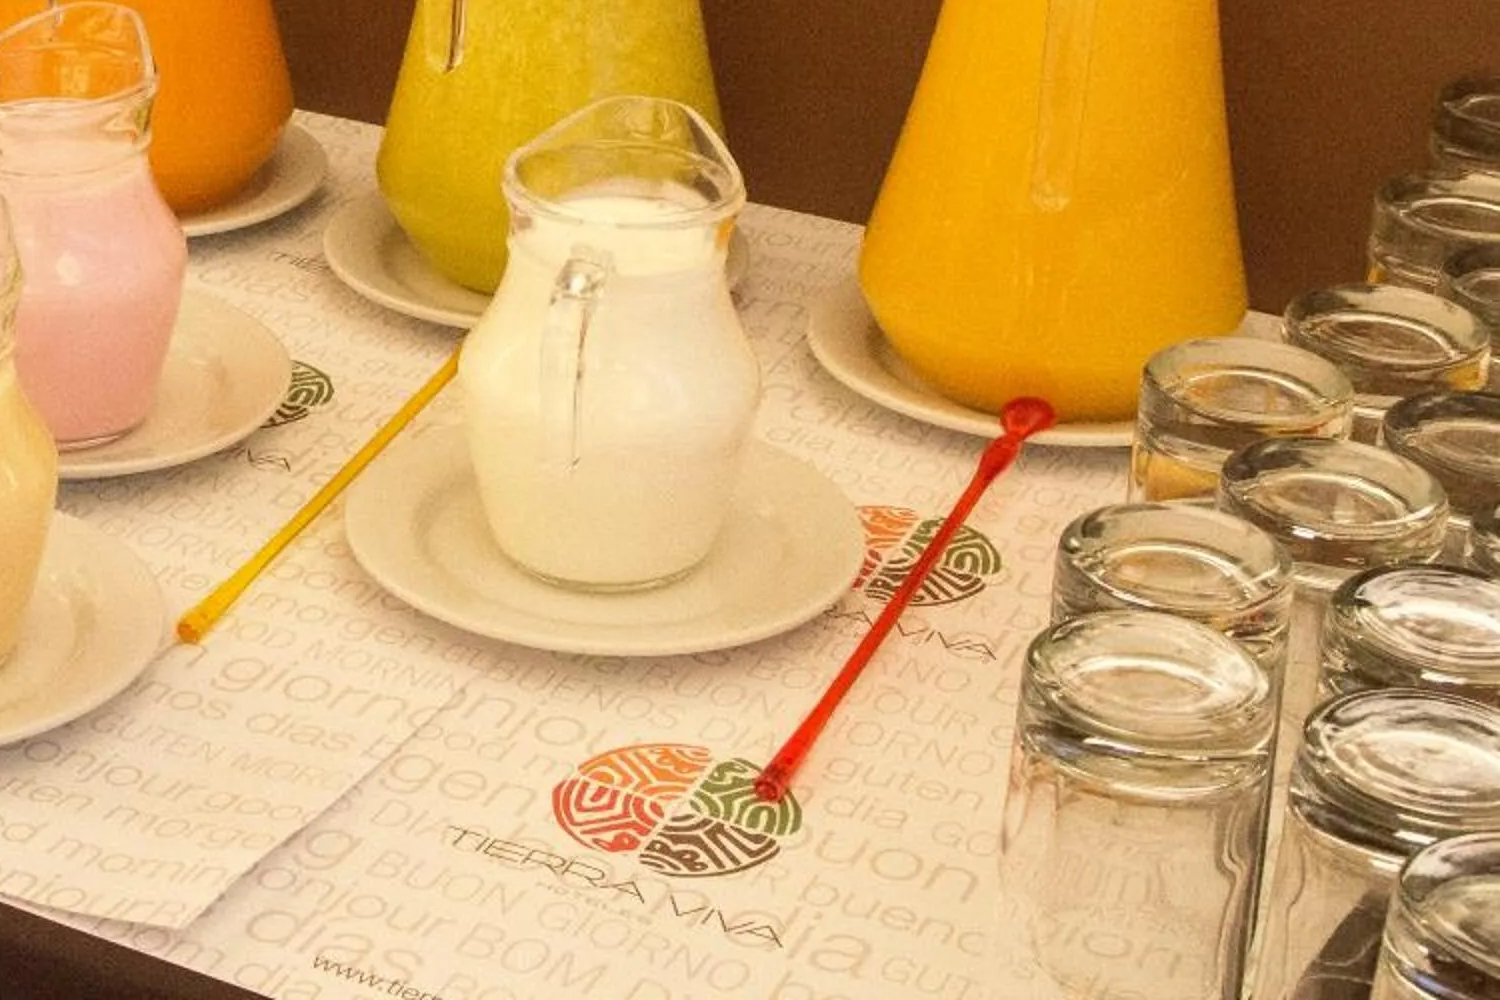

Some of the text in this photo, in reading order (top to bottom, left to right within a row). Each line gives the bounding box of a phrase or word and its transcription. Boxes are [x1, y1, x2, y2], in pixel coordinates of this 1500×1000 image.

[23, 738, 210, 801] onjour
[822, 756, 985, 813] guten
[101, 801, 278, 851] morge
[46, 831, 230, 892] mornin
[449, 824, 784, 949] TIERRA VIVA
[812, 830, 980, 904] uon
[256, 866, 457, 938] onjour
[366, 849, 526, 917] BUON
[536, 900, 751, 992] GIORNO
